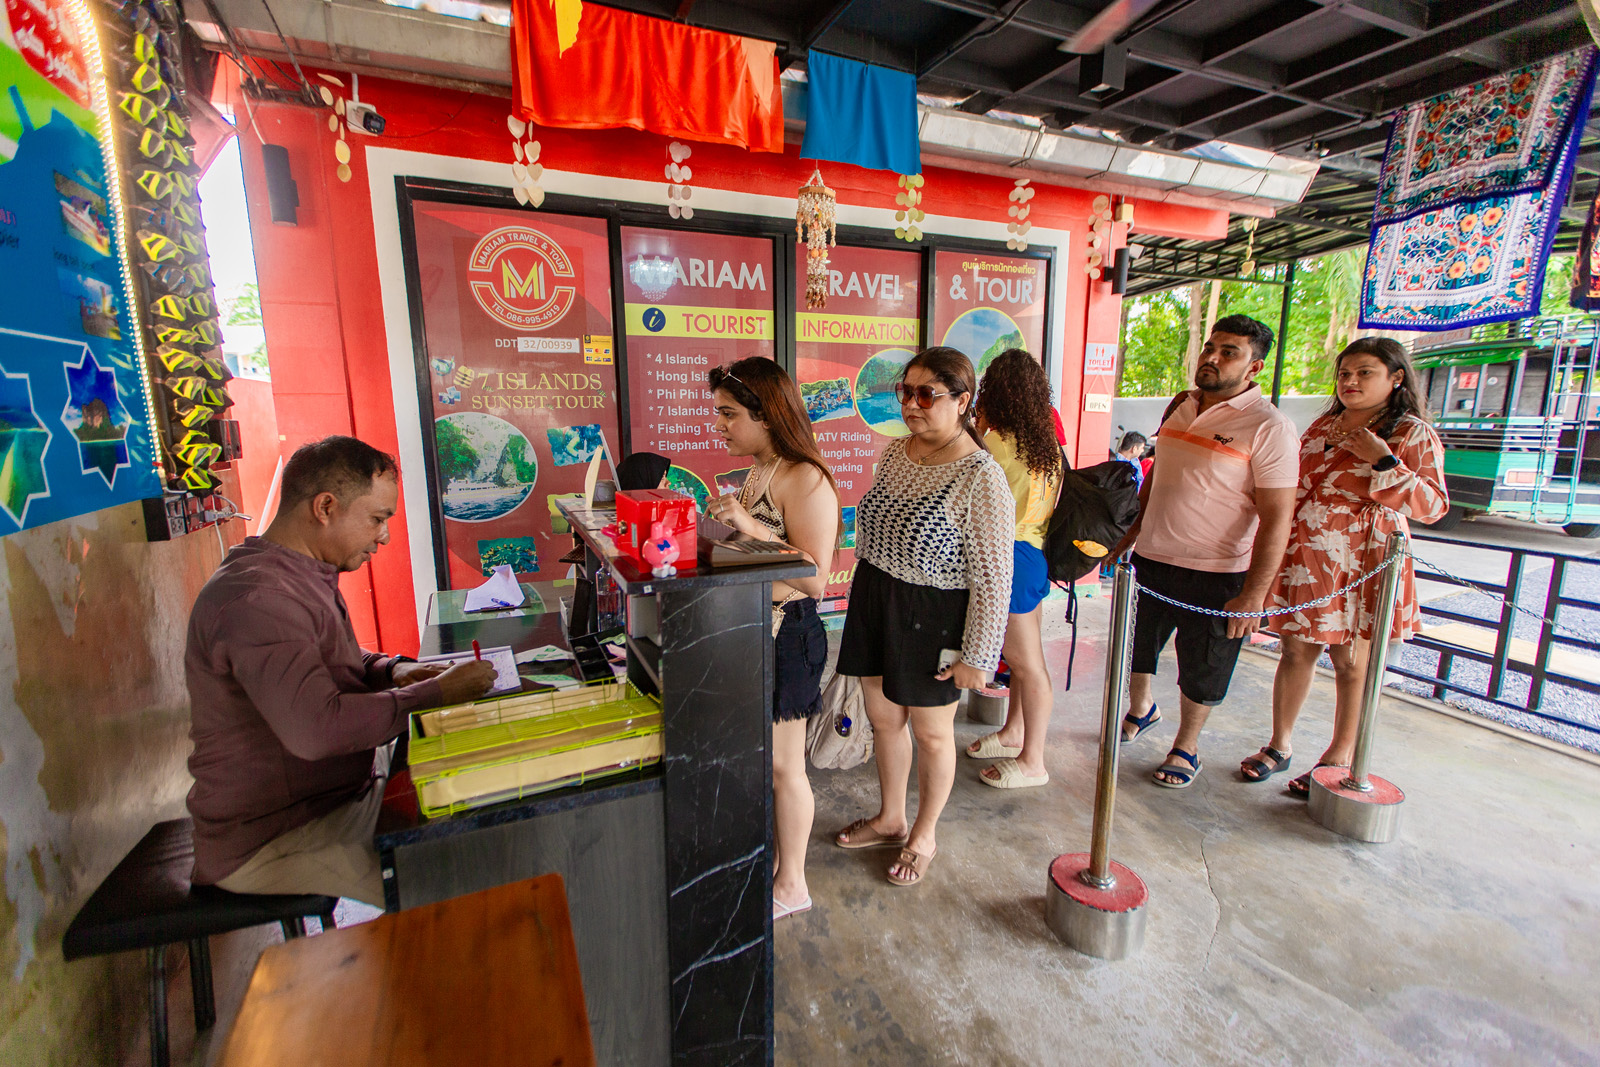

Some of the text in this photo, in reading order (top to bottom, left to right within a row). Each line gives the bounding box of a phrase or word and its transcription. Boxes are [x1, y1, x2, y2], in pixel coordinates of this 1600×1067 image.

[478, 233, 566, 271] MARIAM TRAVEL & TOUR
[634, 254, 767, 291] MARIAM
[949, 274, 968, 301] &
[975, 276, 1033, 305] TOUR
[682, 313, 767, 335] TOURIST
[803, 319, 915, 341] INFORMATION
[523, 339, 573, 350] 32/00939
[655, 353, 708, 365] 4 Islands
[477, 372, 603, 391] 7 ISLANDS
[656, 370, 710, 384] Hong Isla
[656, 388, 676, 400] Phi
[679, 388, 698, 400] Phi
[471, 394, 606, 410] SUNSET TOUR
[657, 406, 664, 417] 7
[667, 405, 709, 417] Islands
[657, 423, 701, 436] Fishing
[817, 431, 871, 444] ATV Riding
[658, 440, 710, 453] Elephant
[853, 447, 875, 457] Tour
